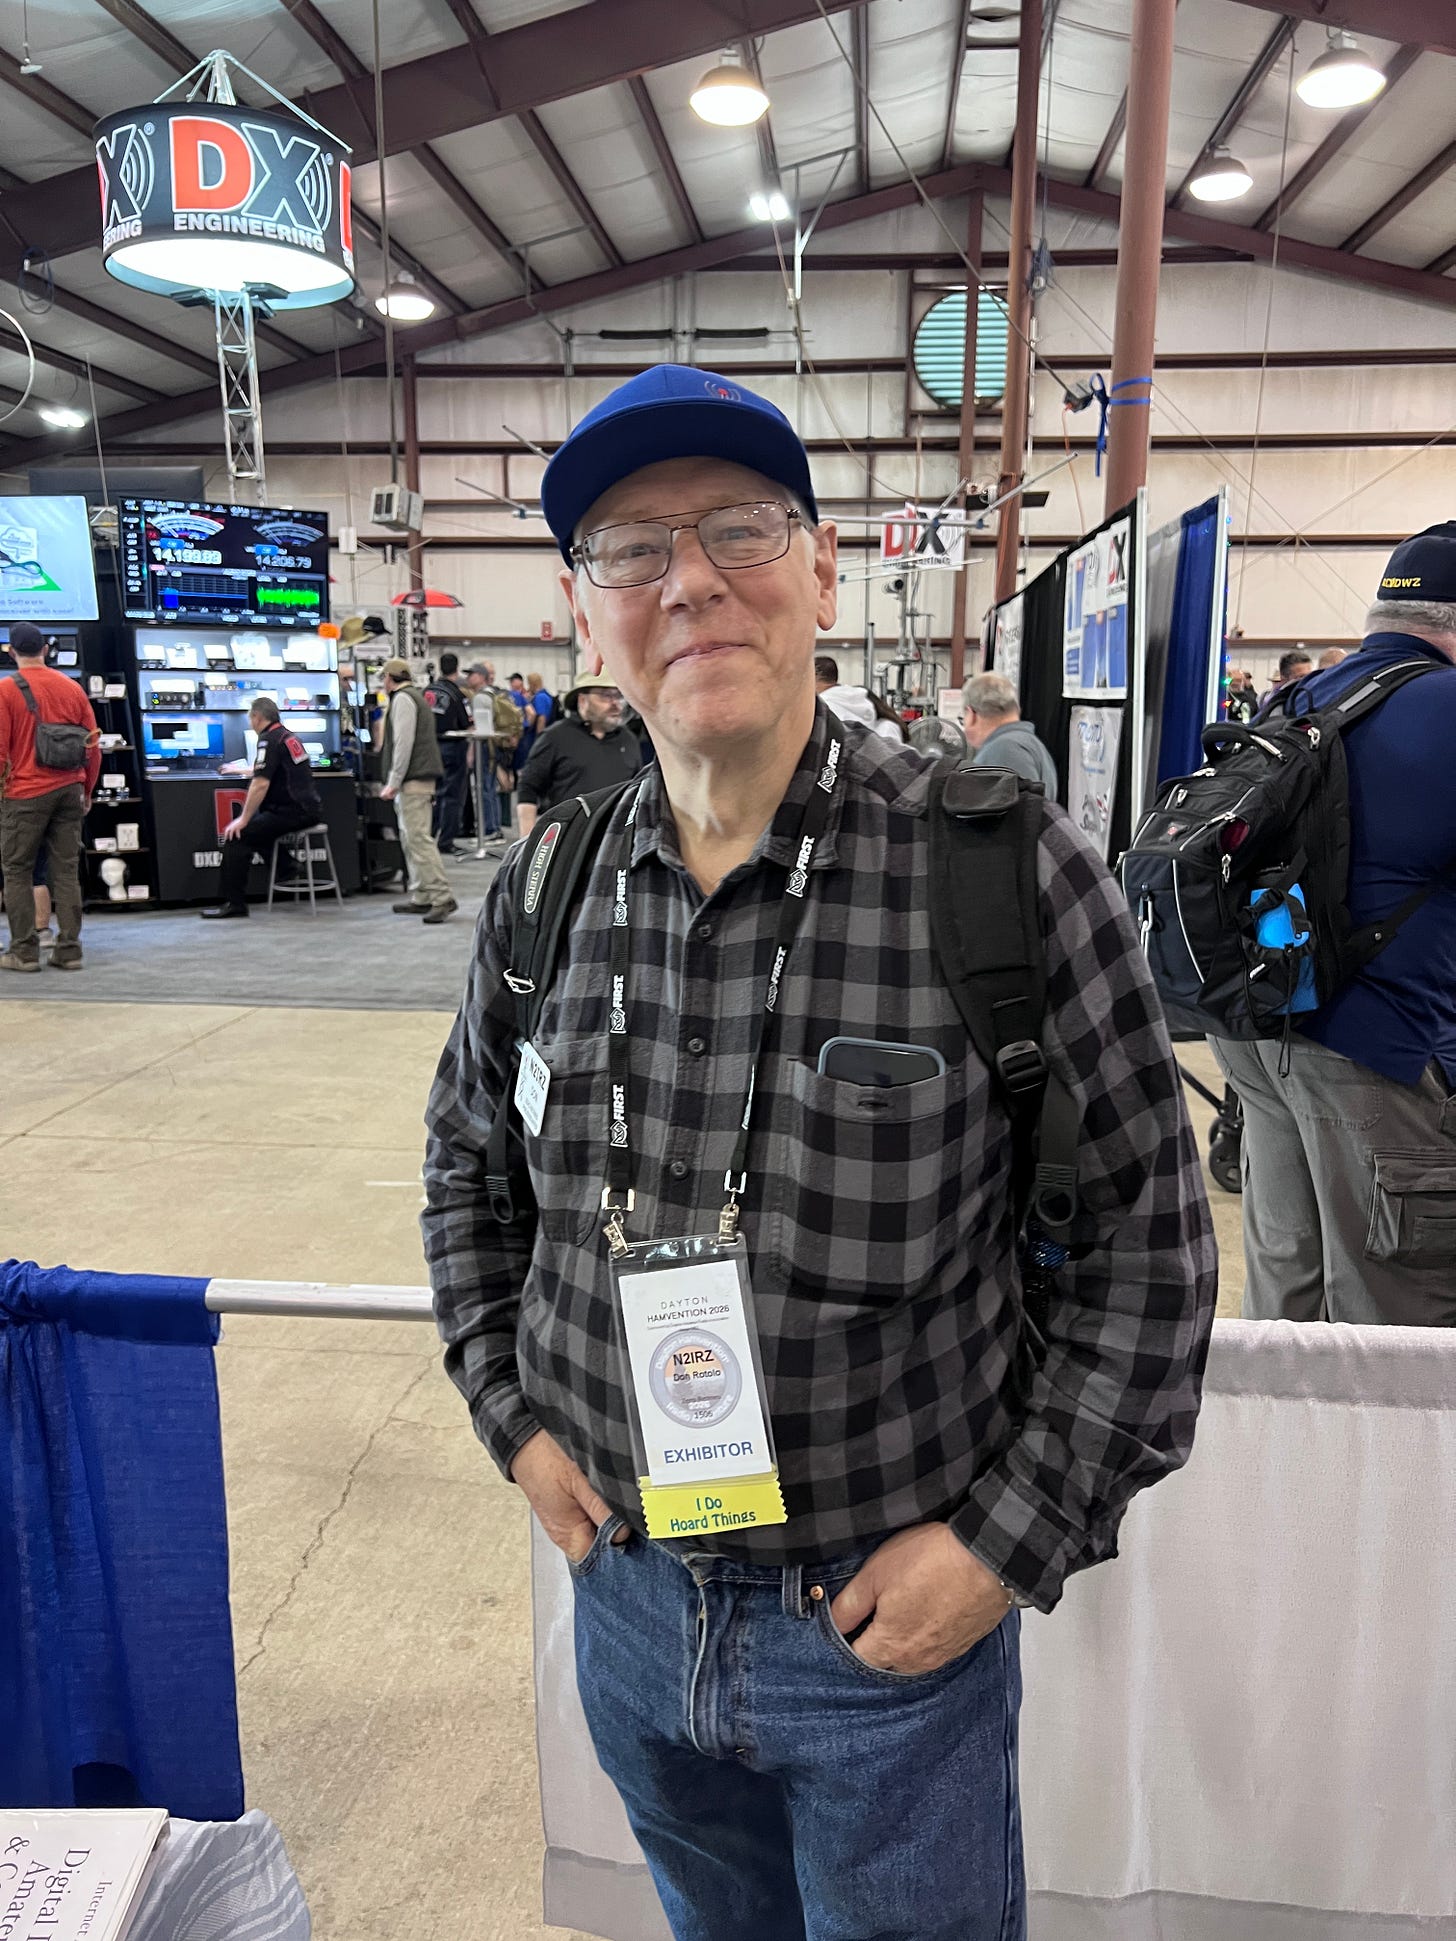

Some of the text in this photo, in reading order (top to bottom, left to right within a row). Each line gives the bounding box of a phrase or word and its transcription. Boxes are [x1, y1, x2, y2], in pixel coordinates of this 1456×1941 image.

[173, 213, 325, 253] ENGINEERING
[827, 739, 842, 769] FIRST
[796, 835, 815, 871] FIRST
[526, 845, 550, 908] HIGH SIERRA
[616, 869, 627, 902] FIRST
[771, 946, 787, 984] FIRST
[612, 974, 624, 1008] FIRST
[613, 1084, 625, 1121] FIRST
[647, 1308, 707, 1323] HAMVENTION
[708, 1305, 730, 1315] 2026
[660, 1295, 708, 1310] DAYTON
[673, 1349, 715, 1366] N2IRZ
[673, 1369, 721, 1382] Don Rotolo
[664, 1441, 754, 1464] EXHIBITOR
[696, 1496, 723, 1511] I Do
[670, 1511, 756, 1532] Hoard Things
[0, 1859, 51, 1941] Amate
[33, 1848, 92, 1926] Digital
[77, 1880, 113, 1936] Internet
